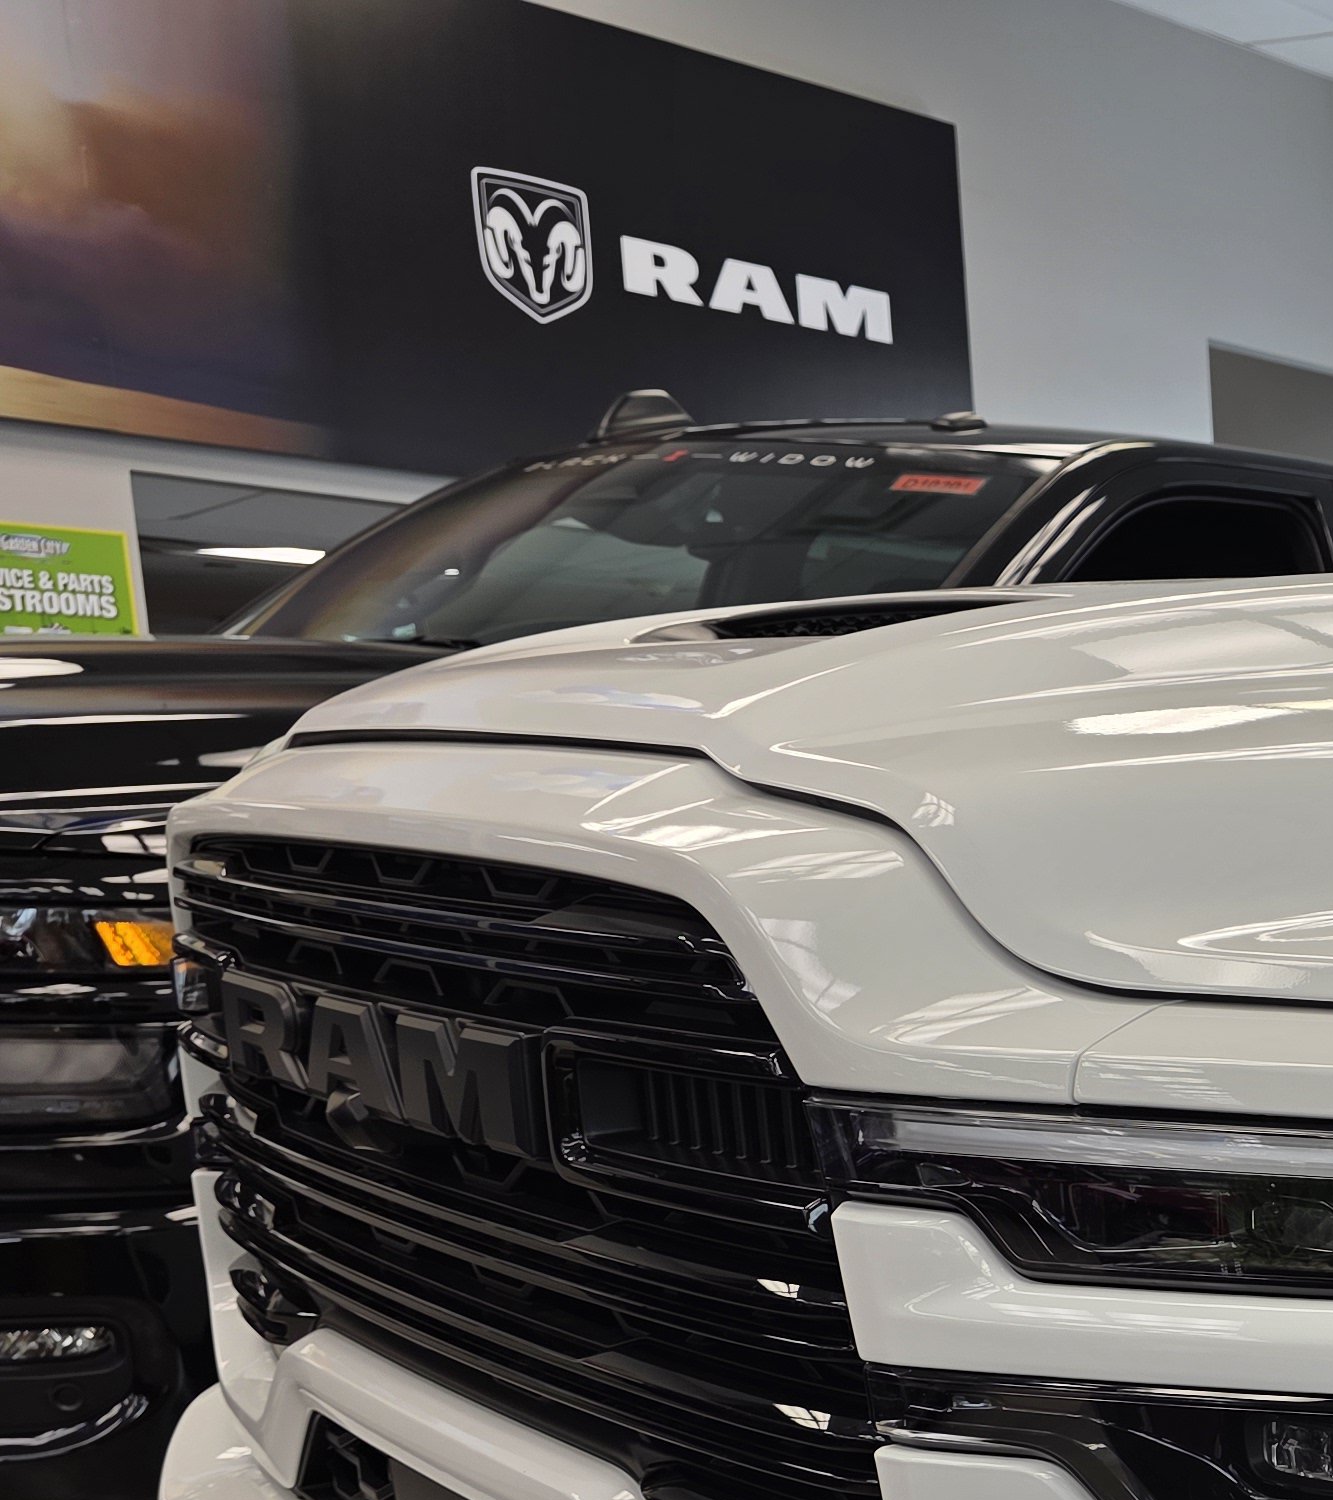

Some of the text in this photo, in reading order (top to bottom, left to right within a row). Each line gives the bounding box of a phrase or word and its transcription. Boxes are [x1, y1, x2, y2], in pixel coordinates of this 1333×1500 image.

[620, 234, 893, 345] RAM
[729, 450, 875, 469] WIDOW
[39, 570, 54, 590] &
[57, 573, 114, 593] PARTS
[0, 588, 118, 619] STROOMS
[221, 968, 536, 1157] RAM
